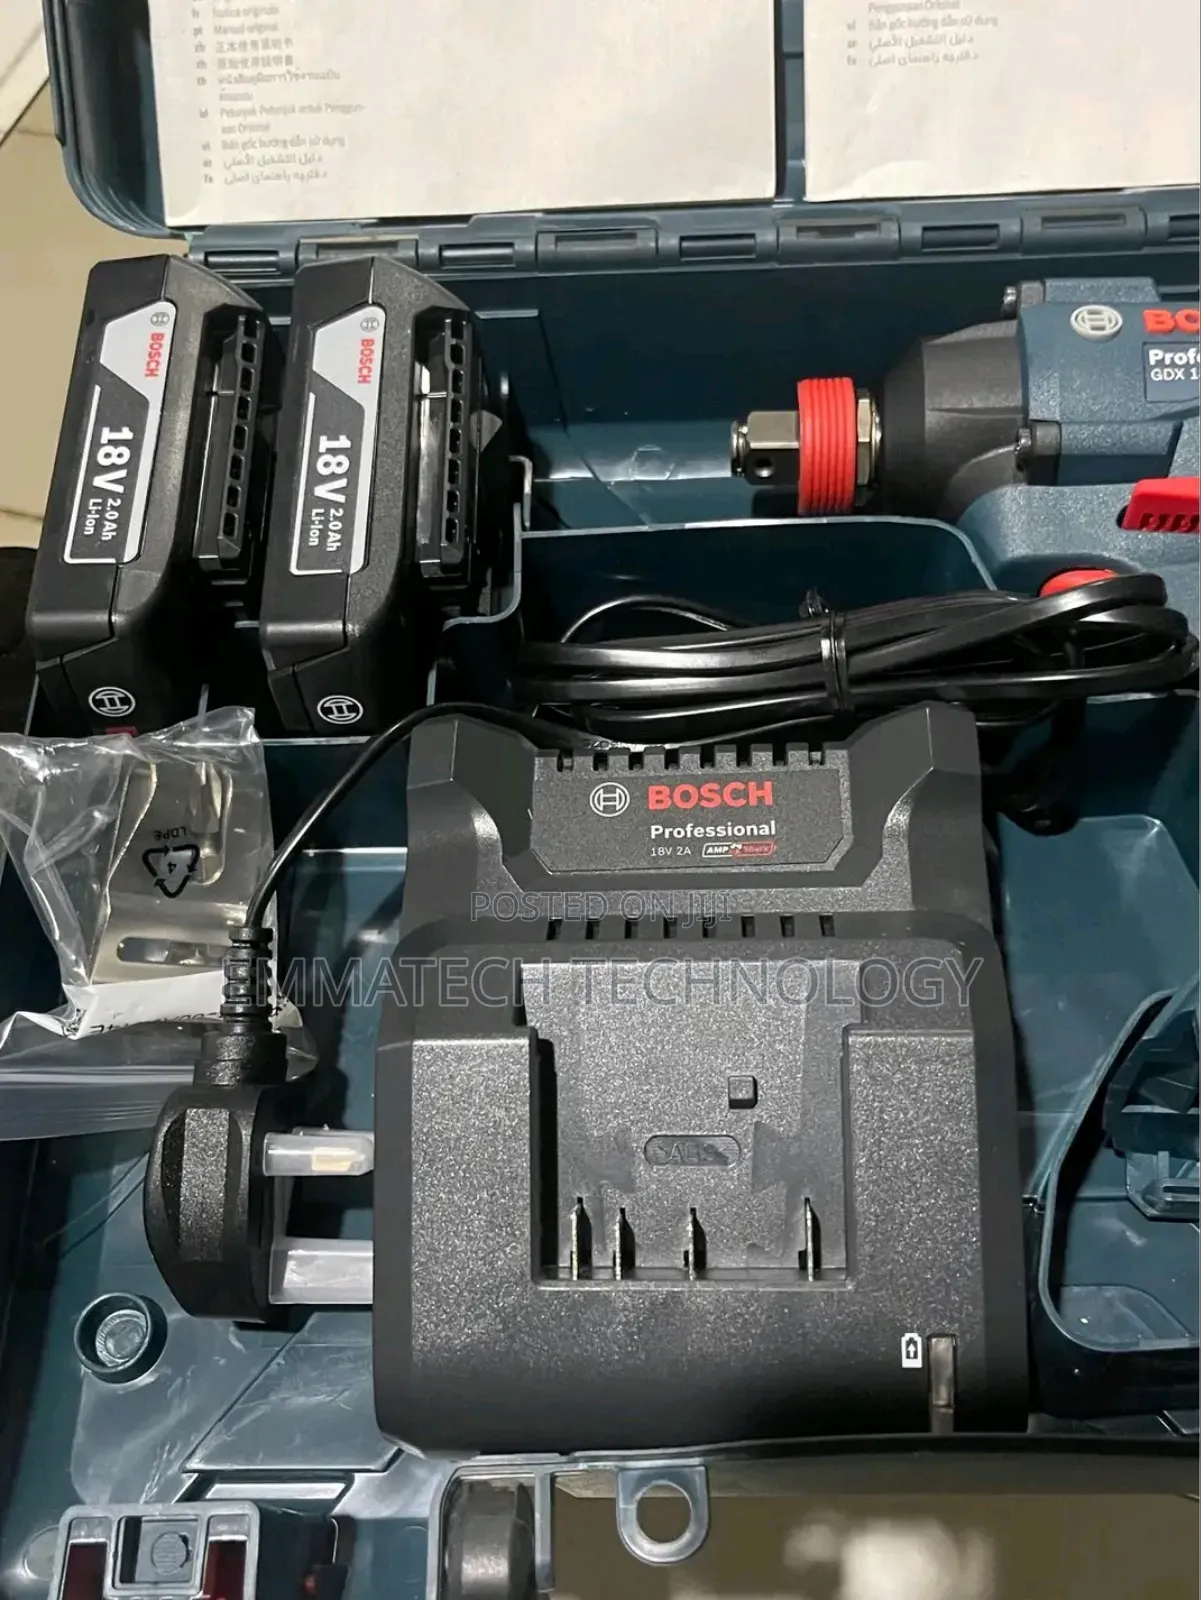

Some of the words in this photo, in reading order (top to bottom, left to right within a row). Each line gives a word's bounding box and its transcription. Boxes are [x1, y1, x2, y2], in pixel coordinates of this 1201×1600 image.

[144, 332, 164, 378] BOSCH
[357, 338, 375, 385] BOSCH
[1150, 367, 1185, 381] GDX
[92, 426, 134, 494] 18V
[313, 434, 352, 504] 18V
[648, 781, 773, 810] BOSCH
[650, 820, 776, 839] Professional
[650, 847, 672, 857] 18V
[676, 846, 692, 856] 2A
